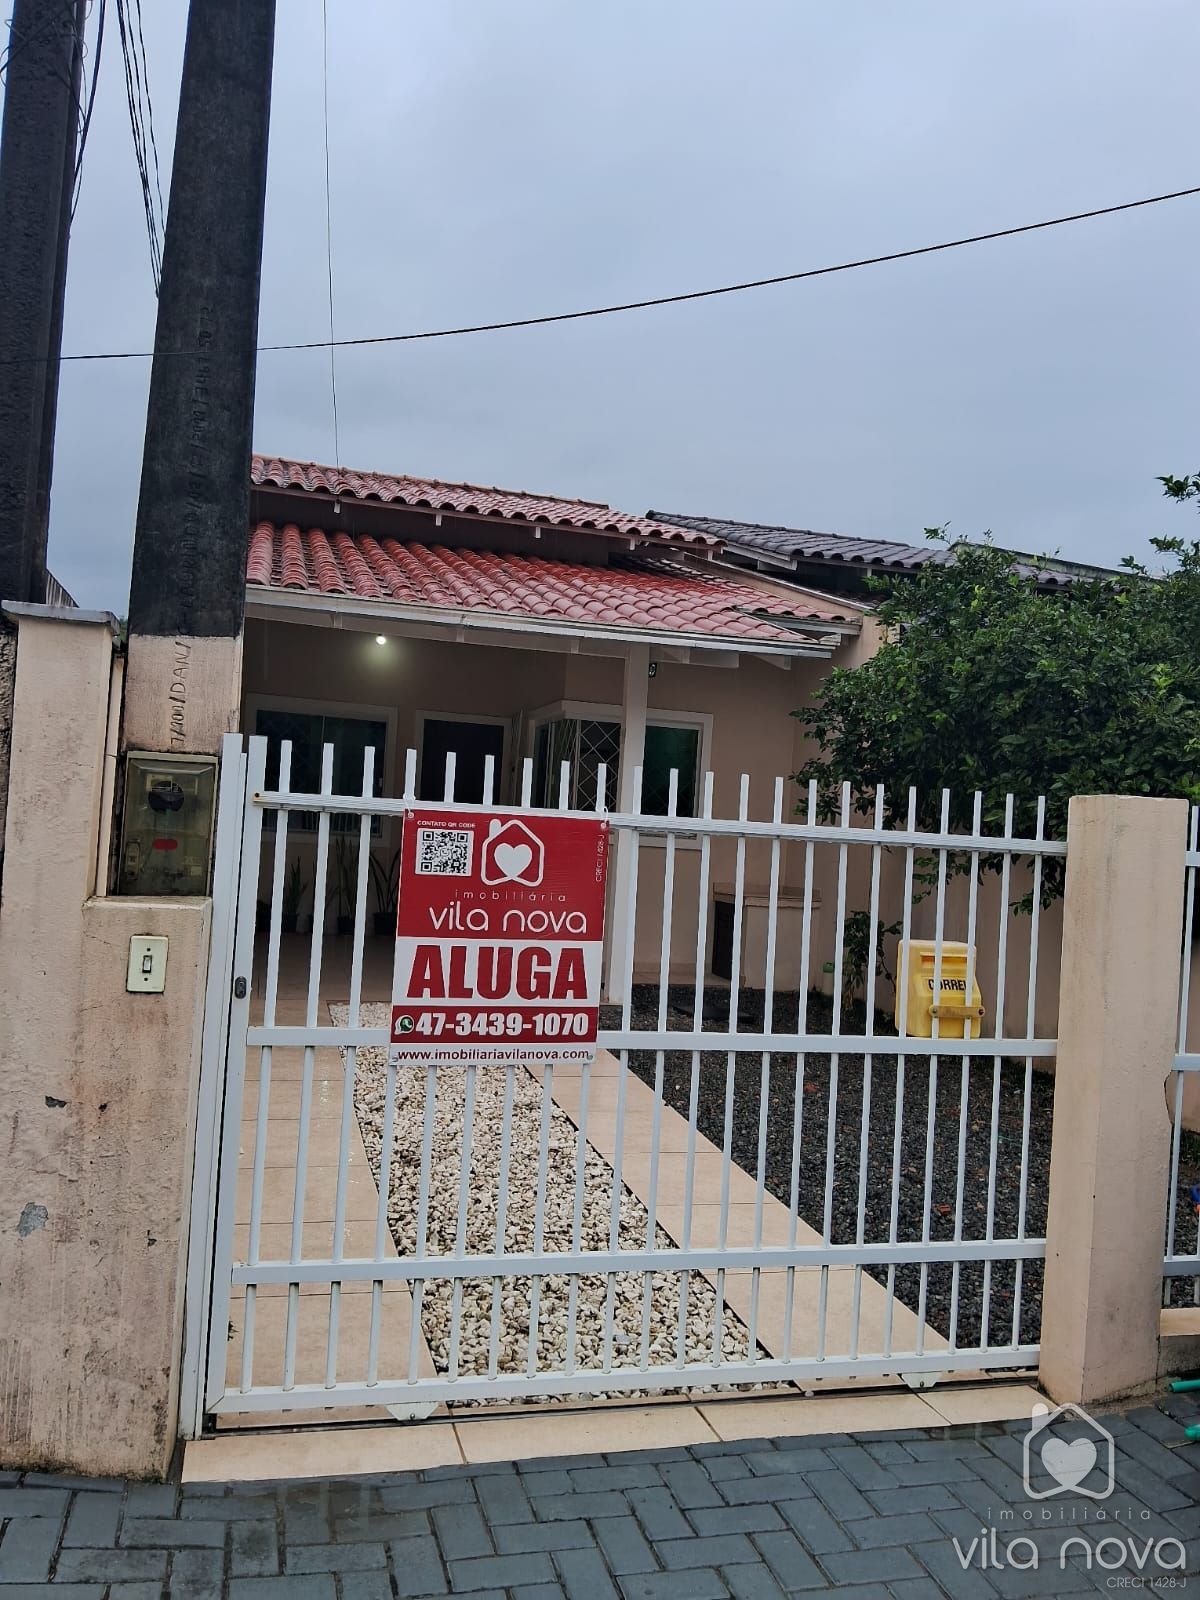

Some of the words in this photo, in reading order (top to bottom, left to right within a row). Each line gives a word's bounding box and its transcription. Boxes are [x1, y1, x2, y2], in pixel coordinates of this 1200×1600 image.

[429, 901, 489, 932] vila
[503, 909, 587, 934] nova
[406, 944, 588, 1001] ALUGA
[416, 1012, 589, 1036] 47-3439-1070
[398, 1048, 589, 1062] www.imobiliariavilanova.com
